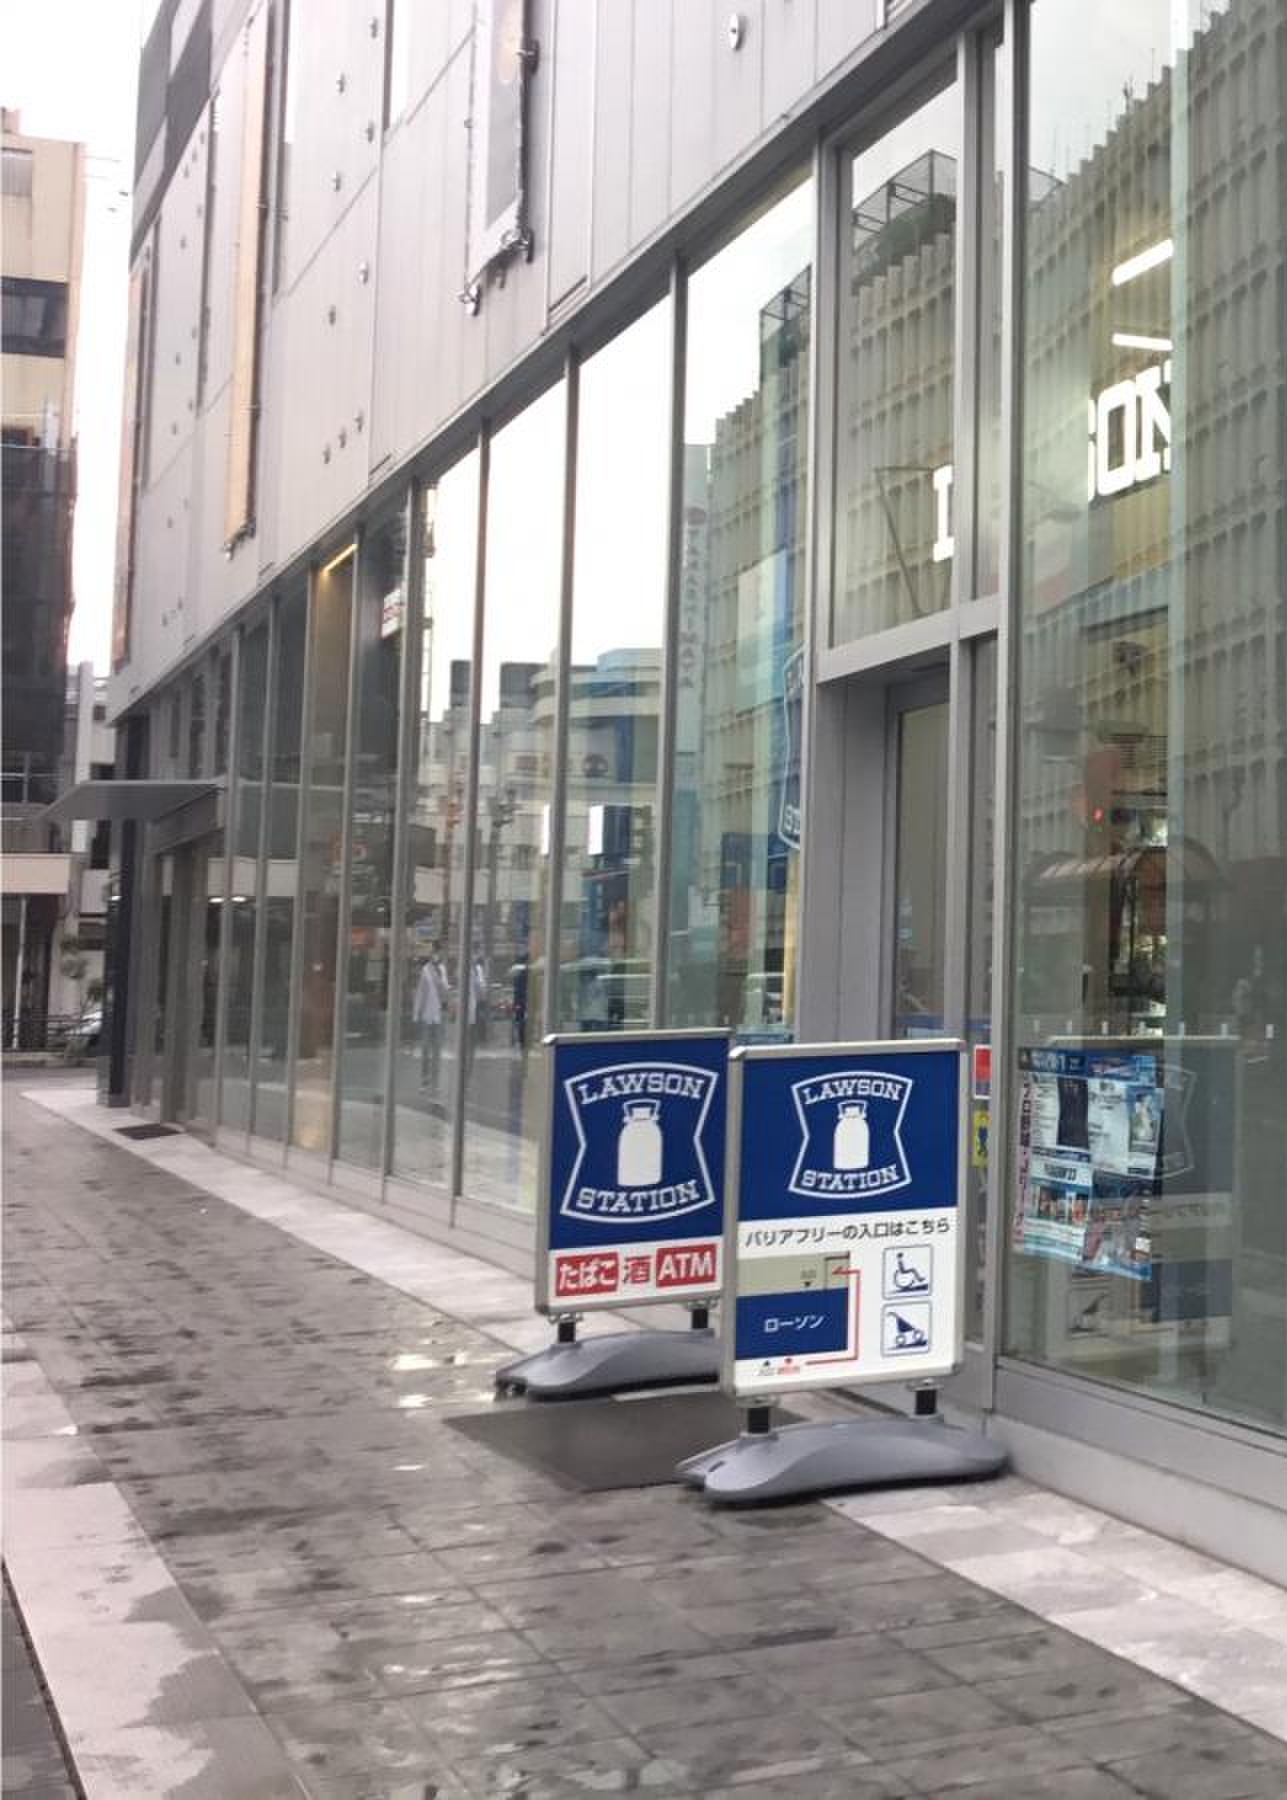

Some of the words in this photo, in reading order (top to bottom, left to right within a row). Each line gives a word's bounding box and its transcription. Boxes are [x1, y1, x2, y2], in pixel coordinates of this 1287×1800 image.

[577, 1071, 705, 1103] LAWSON
[803, 1079, 902, 1103] LAWSON
[801, 1164, 899, 1188] STATION
[576, 1180, 700, 1214] STATION
[745, 1219, 951, 1247] バリアフリーの入口はこちら
[559, 1260, 618, 1292] たばこ
[622, 1256, 651, 1284] 酒
[658, 1250, 715, 1281] ATM
[764, 1315, 825, 1333] ローソン
